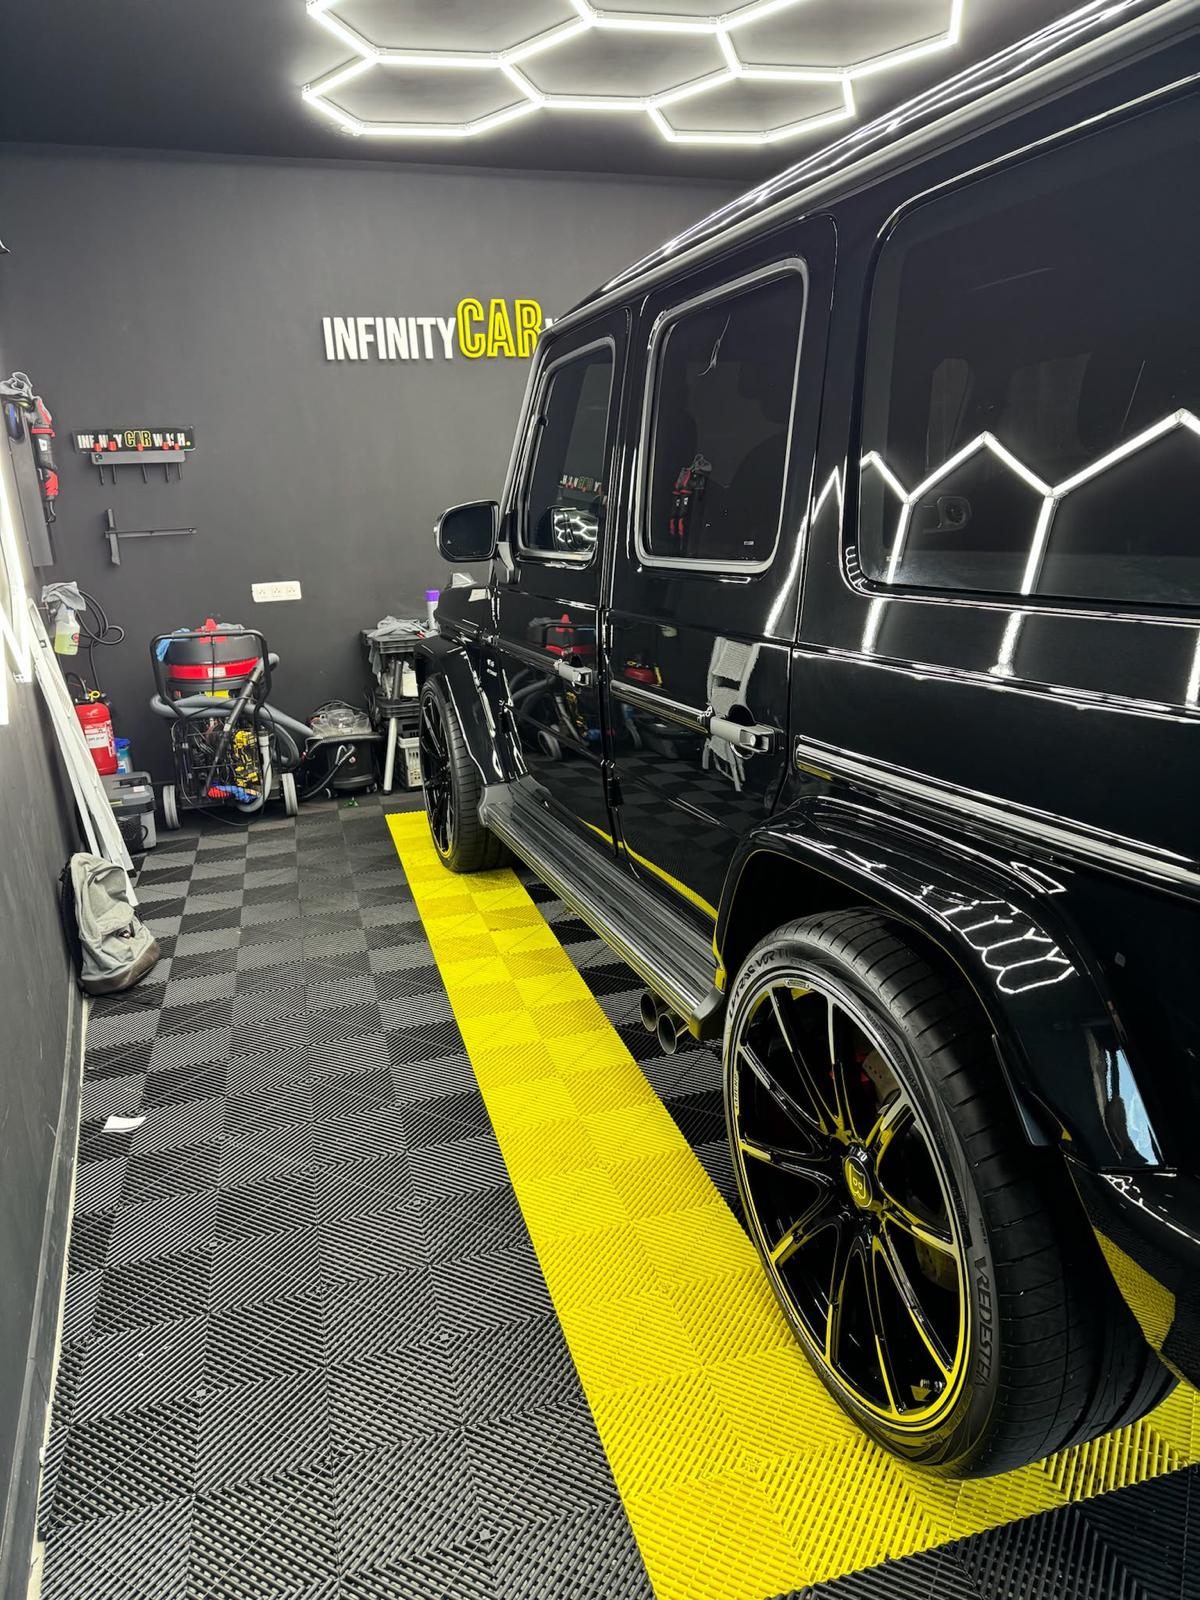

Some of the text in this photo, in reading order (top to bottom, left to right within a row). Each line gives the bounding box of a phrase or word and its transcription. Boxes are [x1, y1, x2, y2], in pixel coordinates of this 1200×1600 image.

[322, 298, 542, 361] INFINITY CAR
[77, 434, 122, 448] INFNIY
